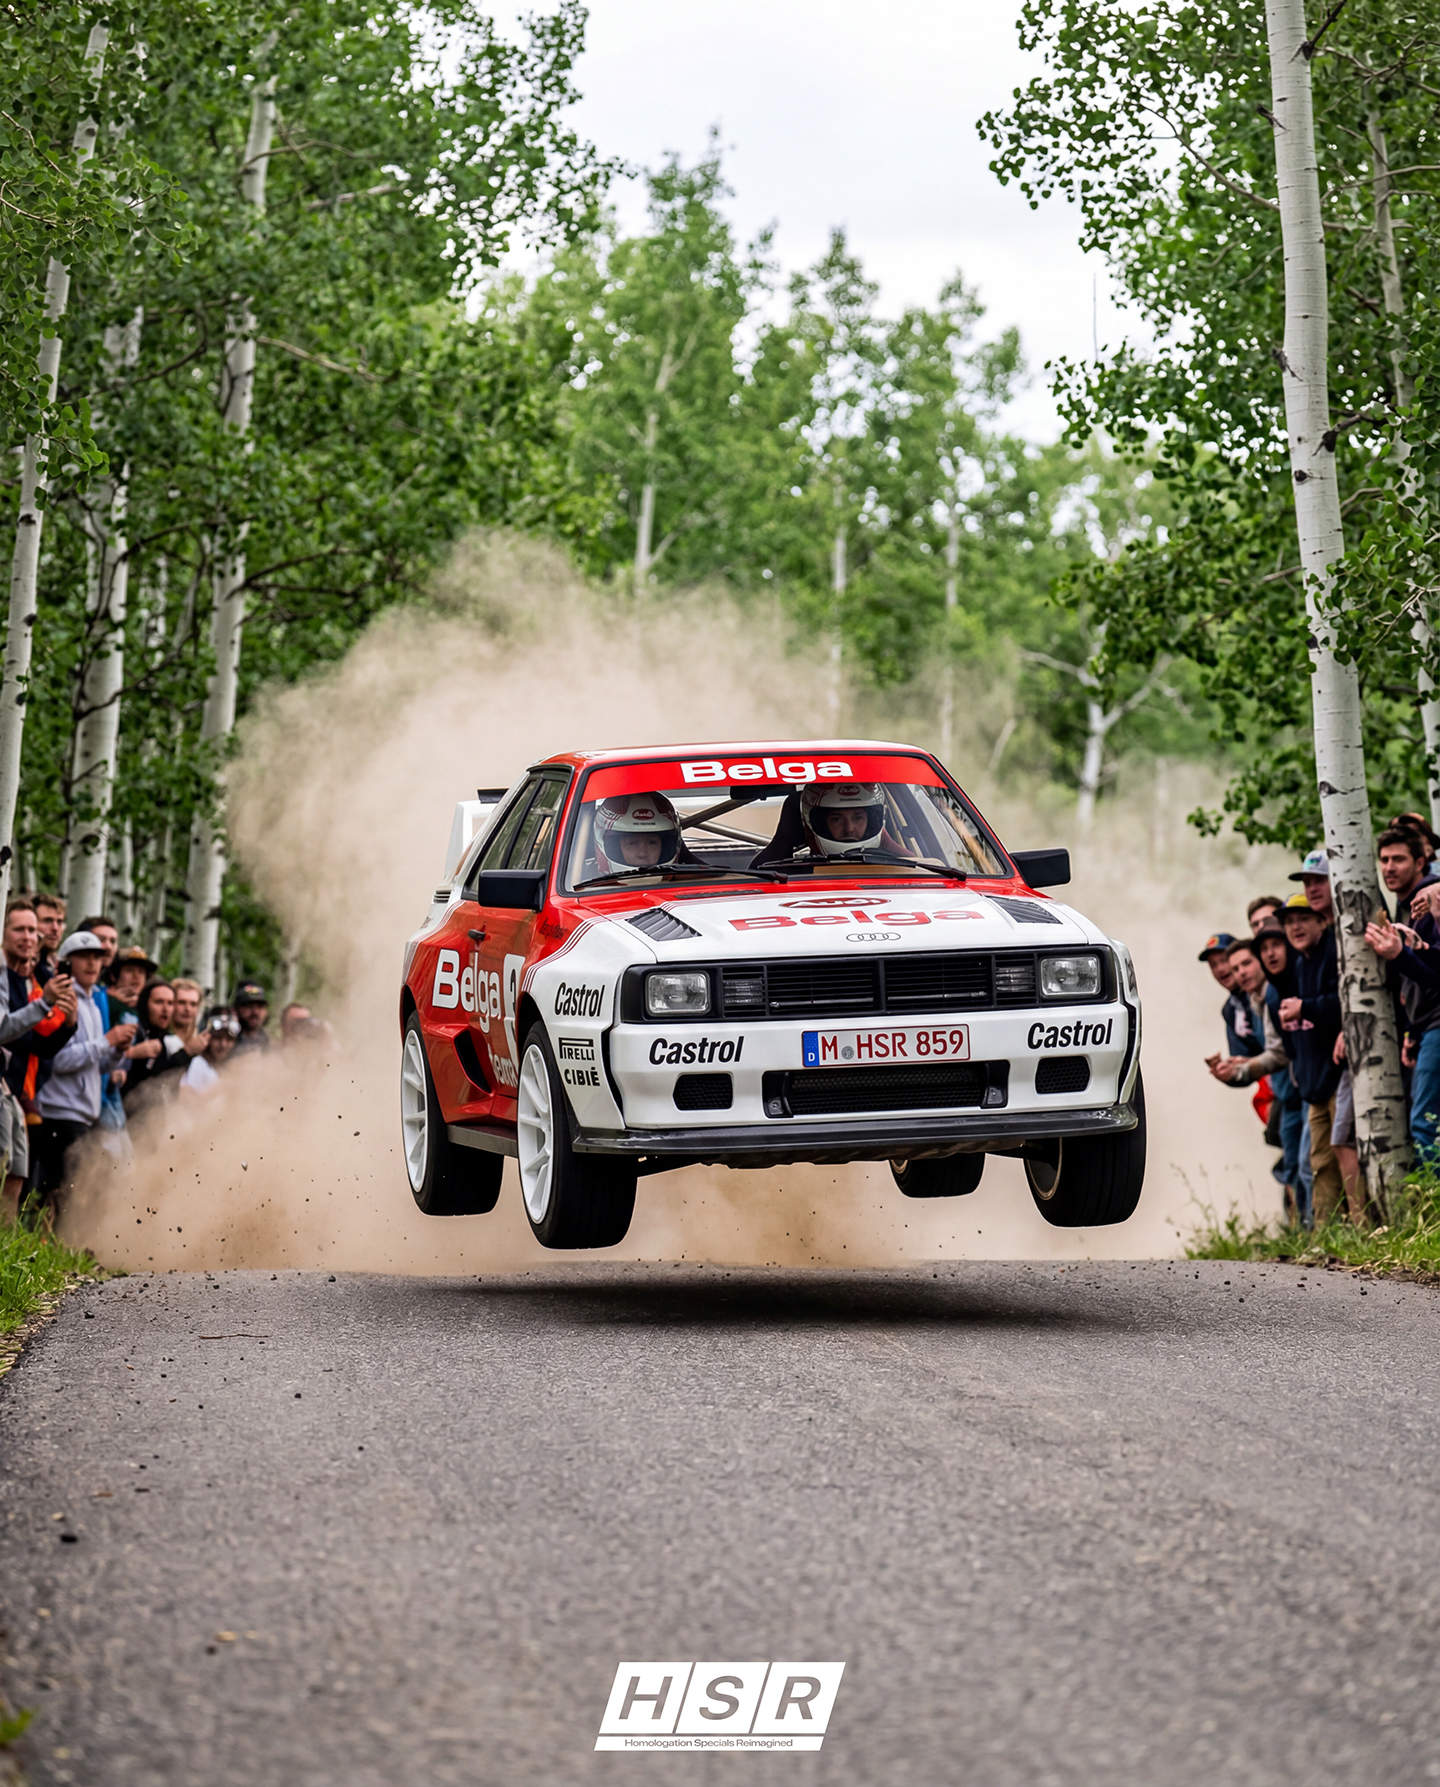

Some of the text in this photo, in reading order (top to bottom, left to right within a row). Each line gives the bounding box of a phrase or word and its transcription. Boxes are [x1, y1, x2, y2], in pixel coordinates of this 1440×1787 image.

[680, 758, 853, 783] Belga
[728, 910, 984, 931] Belga
[432, 949, 501, 1033] Belga
[554, 982, 606, 1017] Castrol
[821, 1036, 838, 1060] M
[856, 1032, 908, 1059] HSR
[916, 1030, 964, 1056] 859
[1027, 1018, 1113, 1049] Castrol
[559, 1037, 595, 1061] PIRELLI
[649, 1036, 744, 1065] Castrol
[808, 1053, 816, 1062] D
